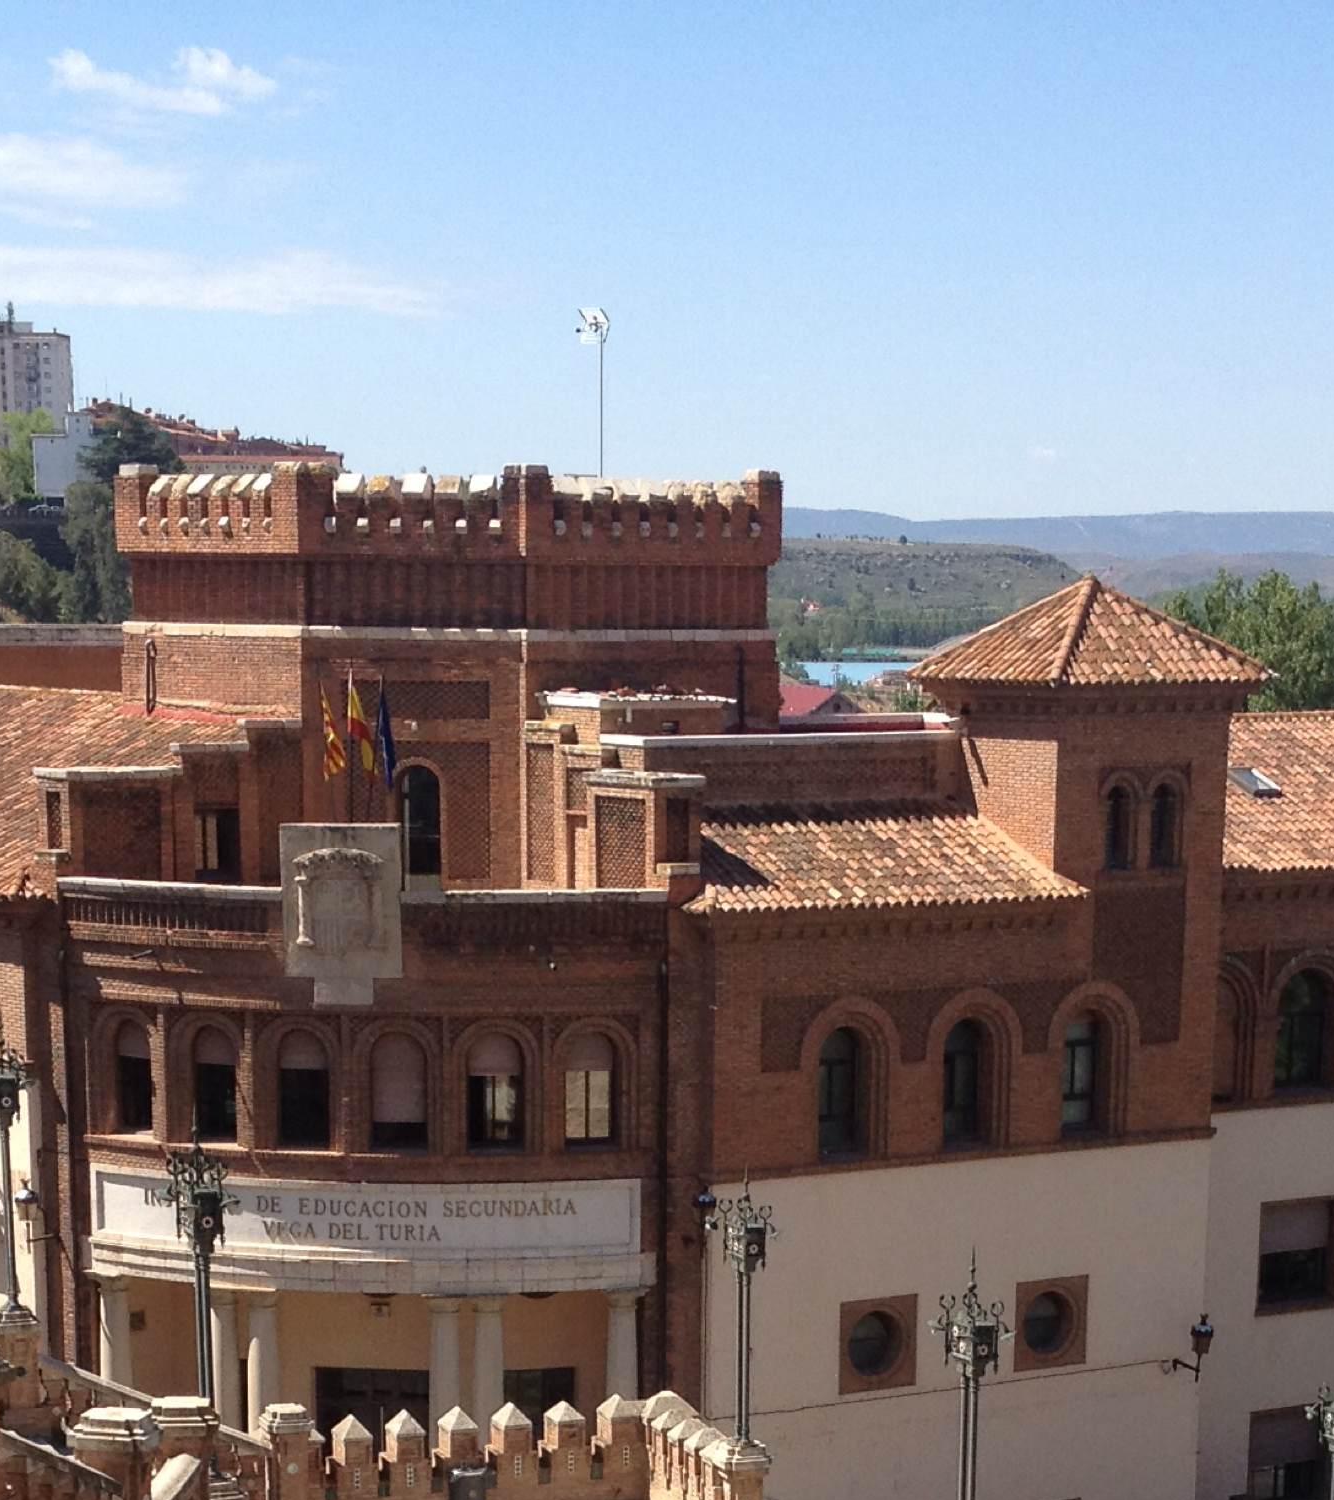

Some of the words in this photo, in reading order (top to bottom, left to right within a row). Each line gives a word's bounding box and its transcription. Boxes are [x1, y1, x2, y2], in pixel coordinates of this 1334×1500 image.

[256, 1195, 282, 1213] DE
[298, 1197, 427, 1218] EDUCACION
[443, 1198, 577, 1217] SECUNDARIA
[262, 1220, 316, 1240] VEGA
[328, 1222, 369, 1240] DEL
[375, 1224, 441, 1241] TURIA
